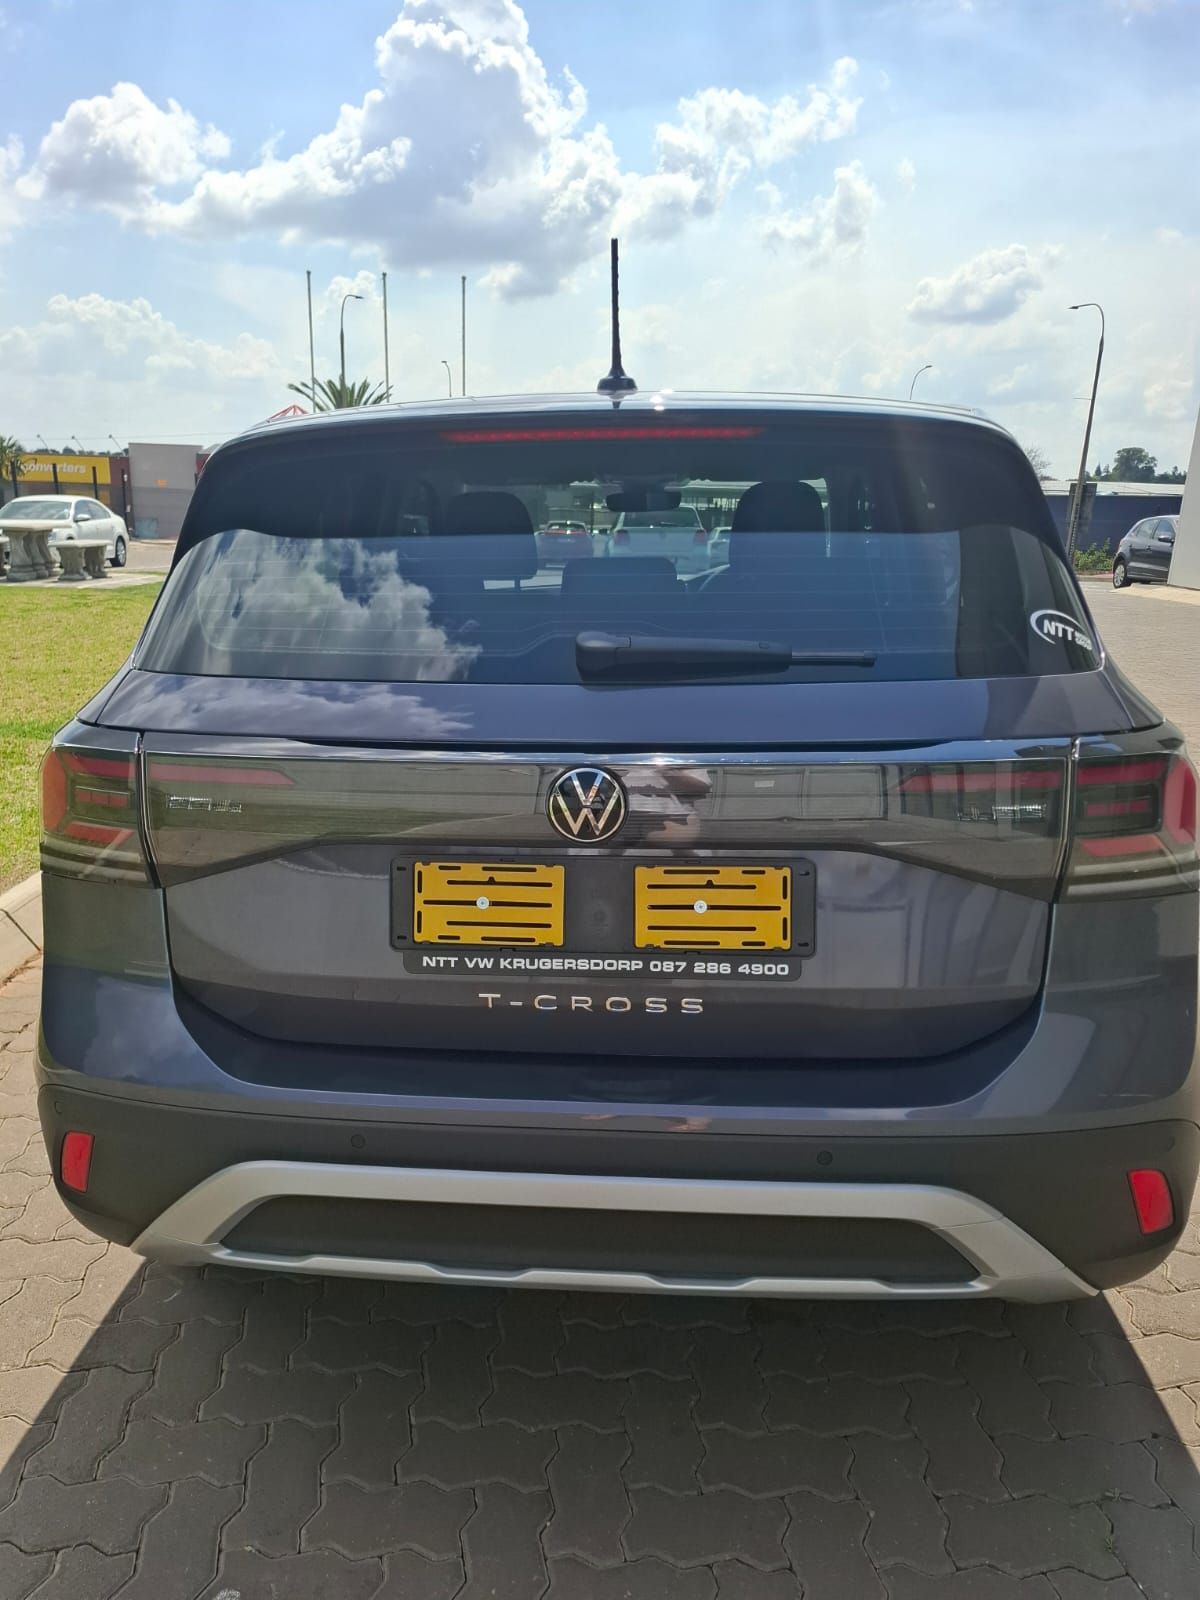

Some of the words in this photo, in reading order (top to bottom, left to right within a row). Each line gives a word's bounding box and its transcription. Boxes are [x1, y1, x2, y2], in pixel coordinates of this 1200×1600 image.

[1043, 619, 1074, 640] NTT
[422, 956, 458, 968] NTT
[464, 957, 494, 969] VW
[500, 958, 643, 971] KRUGERSDORP
[649, 960, 687, 973] 087
[693, 962, 732, 974] 286
[738, 963, 790, 976] 4900
[478, 993, 704, 1014] T-CROSS
